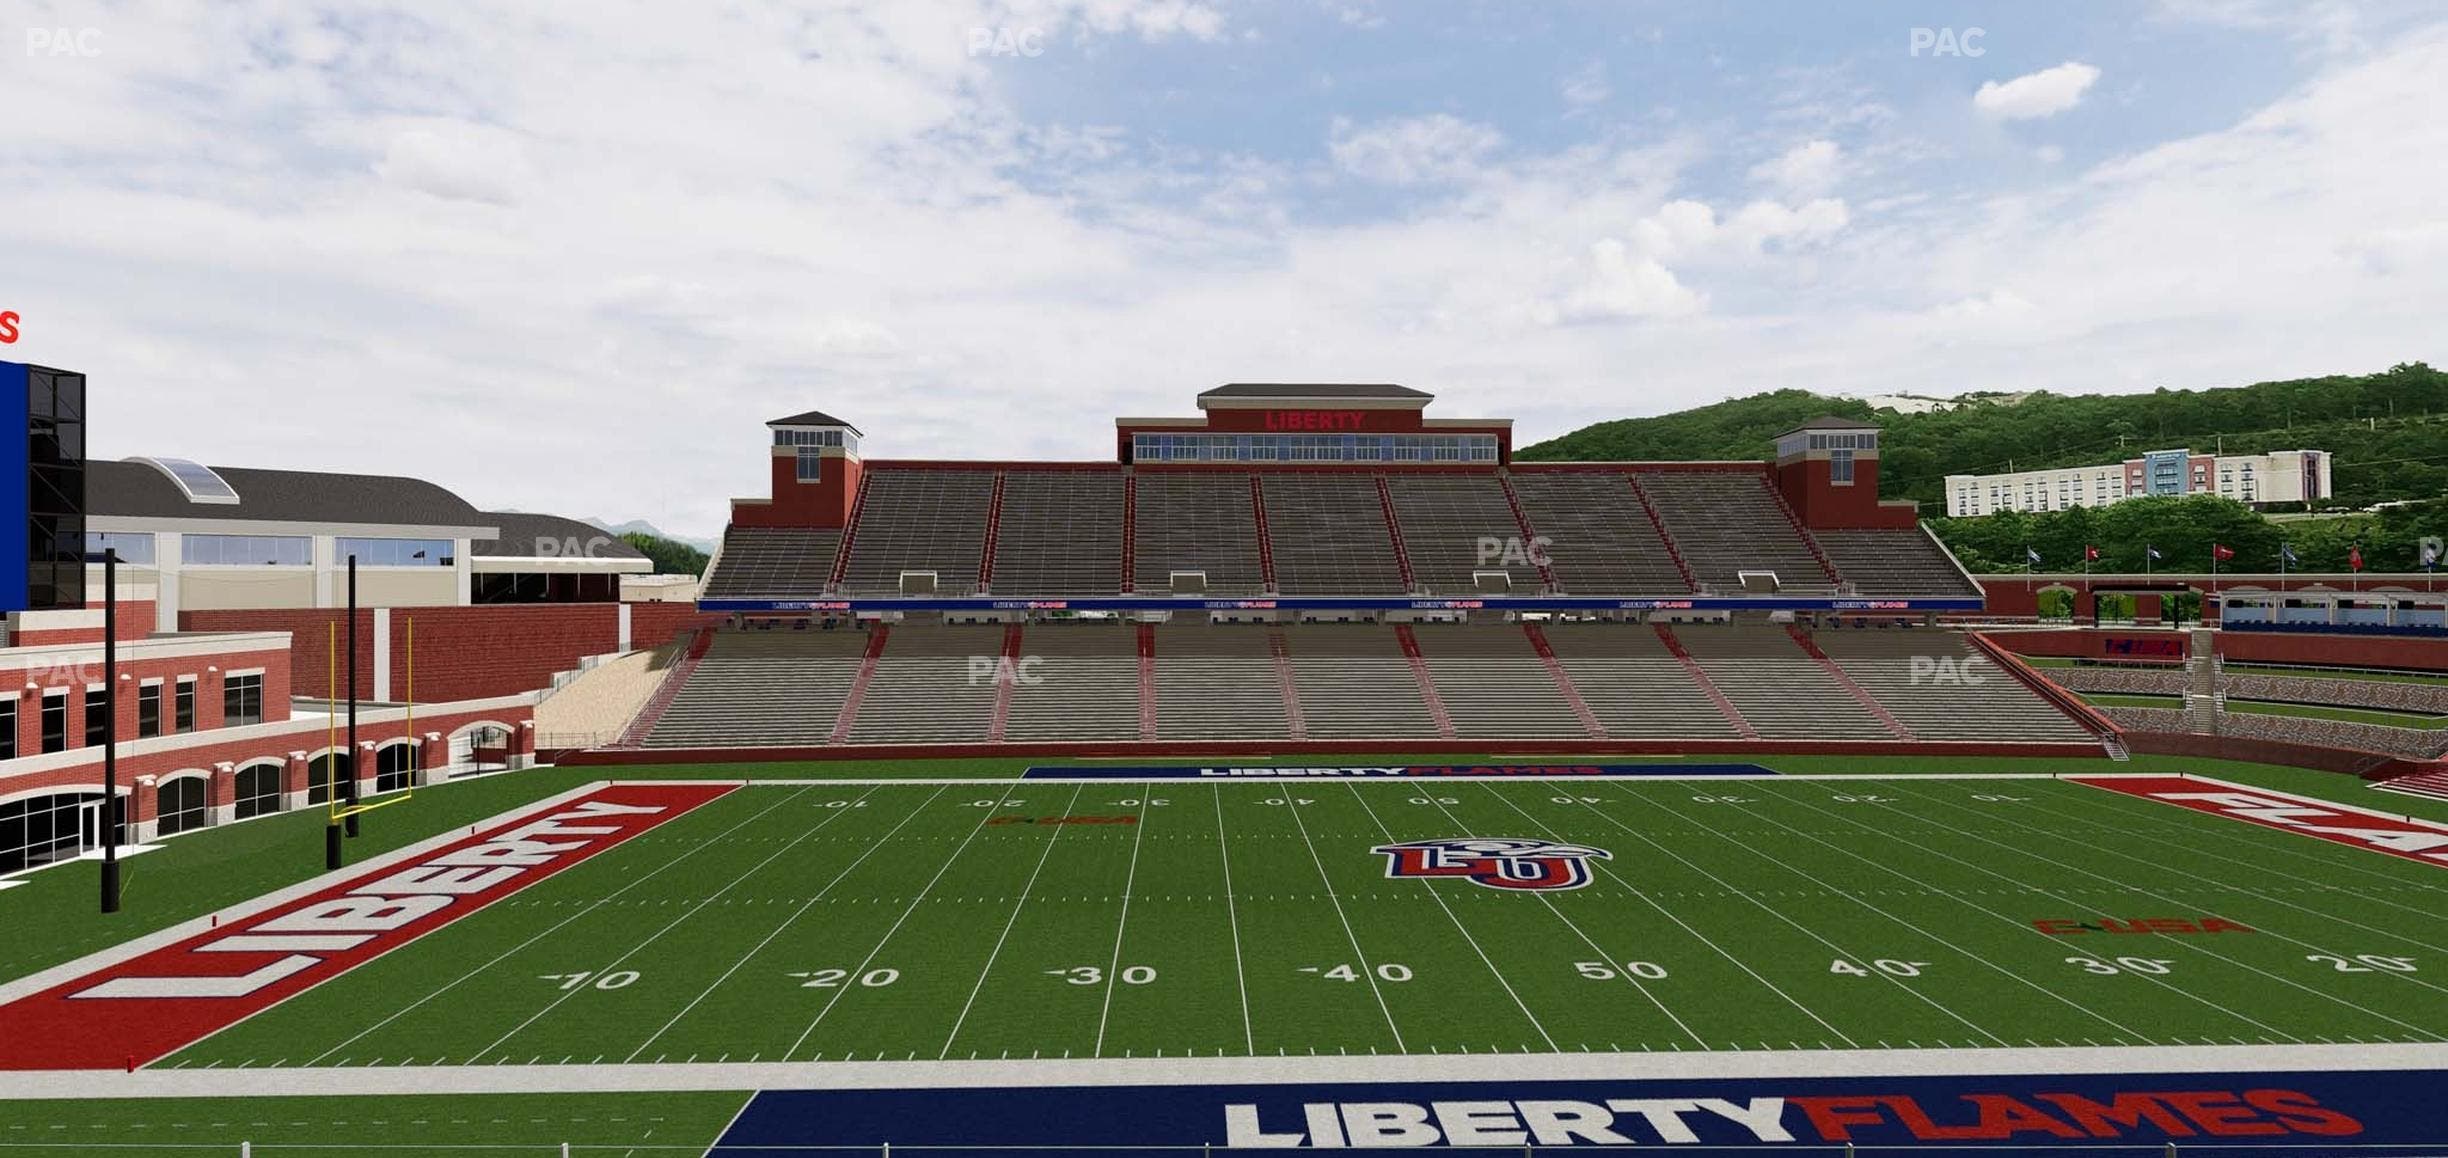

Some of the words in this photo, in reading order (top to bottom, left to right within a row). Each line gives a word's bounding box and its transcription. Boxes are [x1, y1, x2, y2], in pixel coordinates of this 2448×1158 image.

[1265, 410, 1366, 430] LIBERTY
[66, 801, 668, 1000] LIBERTY
[1323, 963, 1413, 982] 40
[1574, 962, 1668, 980] 50
[1830, 959, 1920, 977] 40
[2065, 956, 2170, 974] 30
[2306, 954, 2418, 972] 20
[560, 971, 640, 990] 10
[801, 968, 899, 987] 20
[1067, 965, 1157, 985] 30
